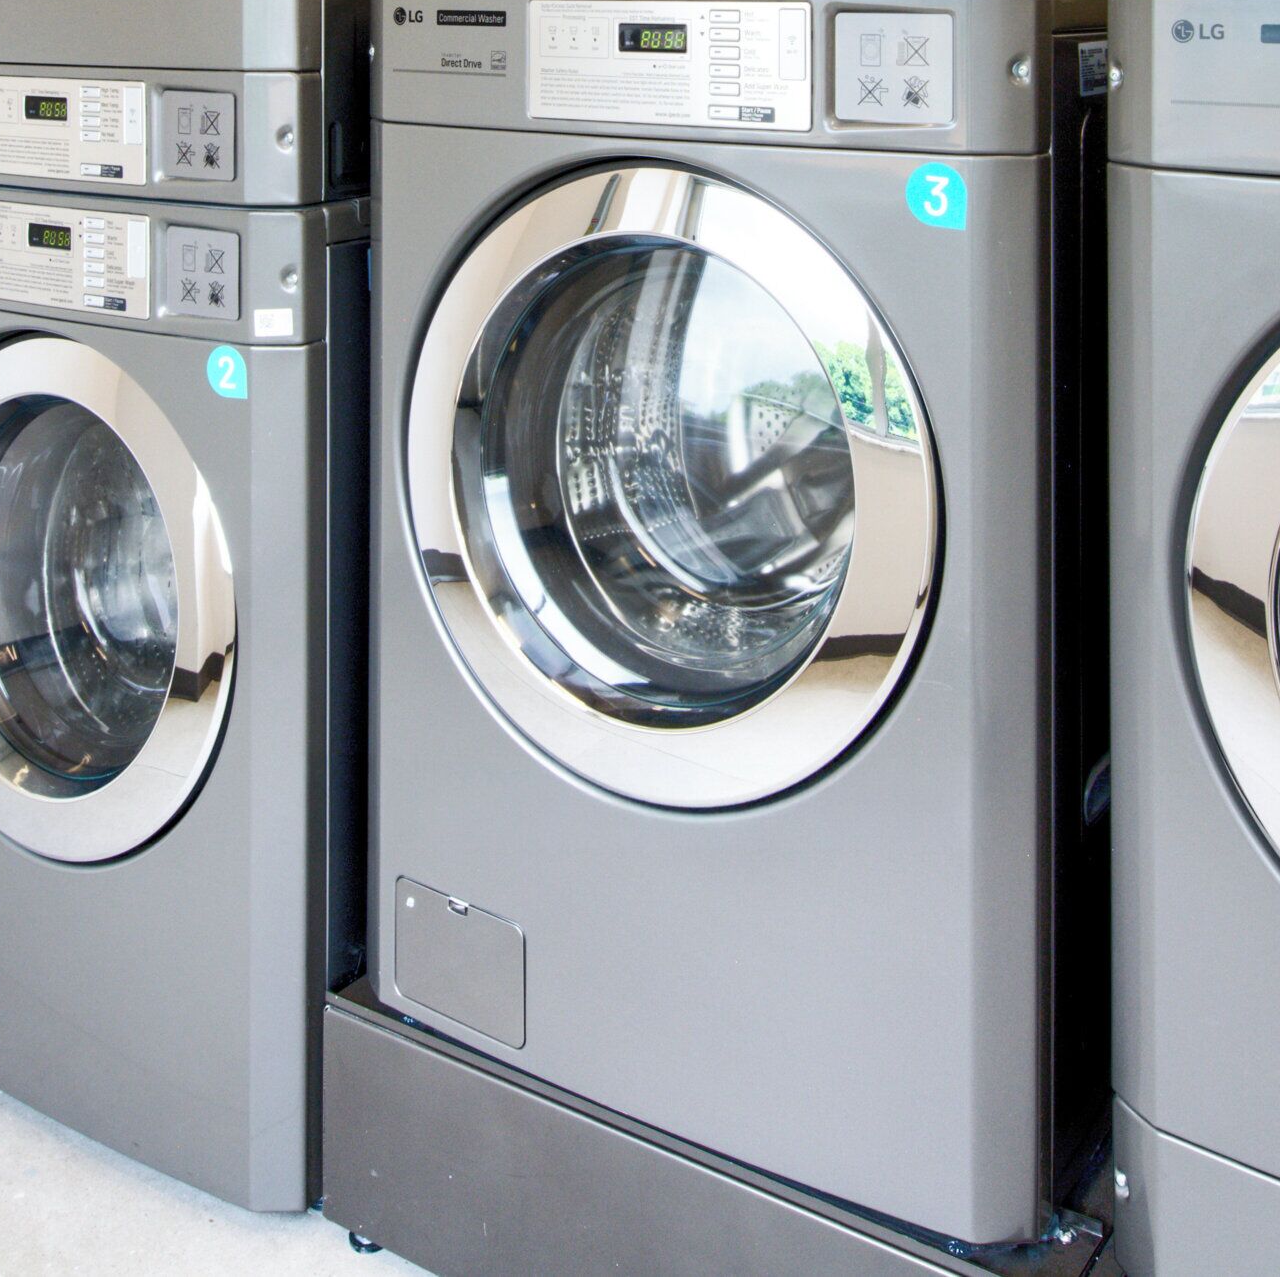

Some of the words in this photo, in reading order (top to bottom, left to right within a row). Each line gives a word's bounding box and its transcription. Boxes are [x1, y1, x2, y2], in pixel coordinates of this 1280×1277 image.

[408, 10, 424, 23] LG
[439, 13, 477, 23] Commercial
[478, 14, 505, 24] Washer
[1199, 23, 1225, 40] LG
[441, 58, 462, 68] Direct
[464, 58, 482, 69] Drive
[923, 175, 949, 218] 3
[217, 355, 237, 390] 2
